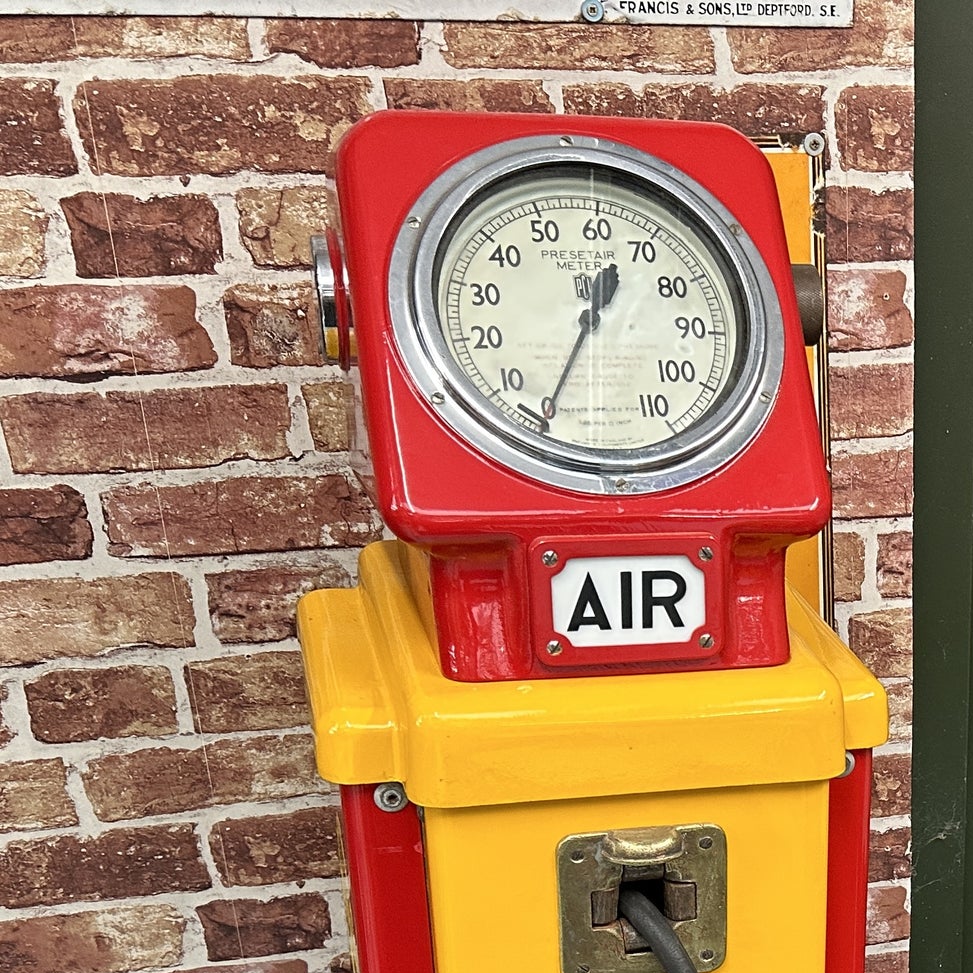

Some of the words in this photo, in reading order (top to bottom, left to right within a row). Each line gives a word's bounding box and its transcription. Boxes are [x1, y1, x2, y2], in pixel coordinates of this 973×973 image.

[620, 1, 679, 14] FRANCIS
[686, 3, 695, 15] &
[530, 220, 560, 243] 50
[582, 219, 612, 241] 60
[488, 244, 521, 267] 40
[541, 249, 616, 261] PRESETAIR
[627, 241, 656, 263] 70
[556, 261, 604, 272] METER
[471, 283, 500, 306] 30
[658, 276, 687, 299] 80
[471, 325, 502, 349] 20
[675, 317, 706, 339] 90
[501, 368, 524, 391] 10
[658, 359, 696, 383] 100
[541, 397, 557, 419] 0
[640, 393, 669, 418] 110
[567, 570, 687, 632] AIR
